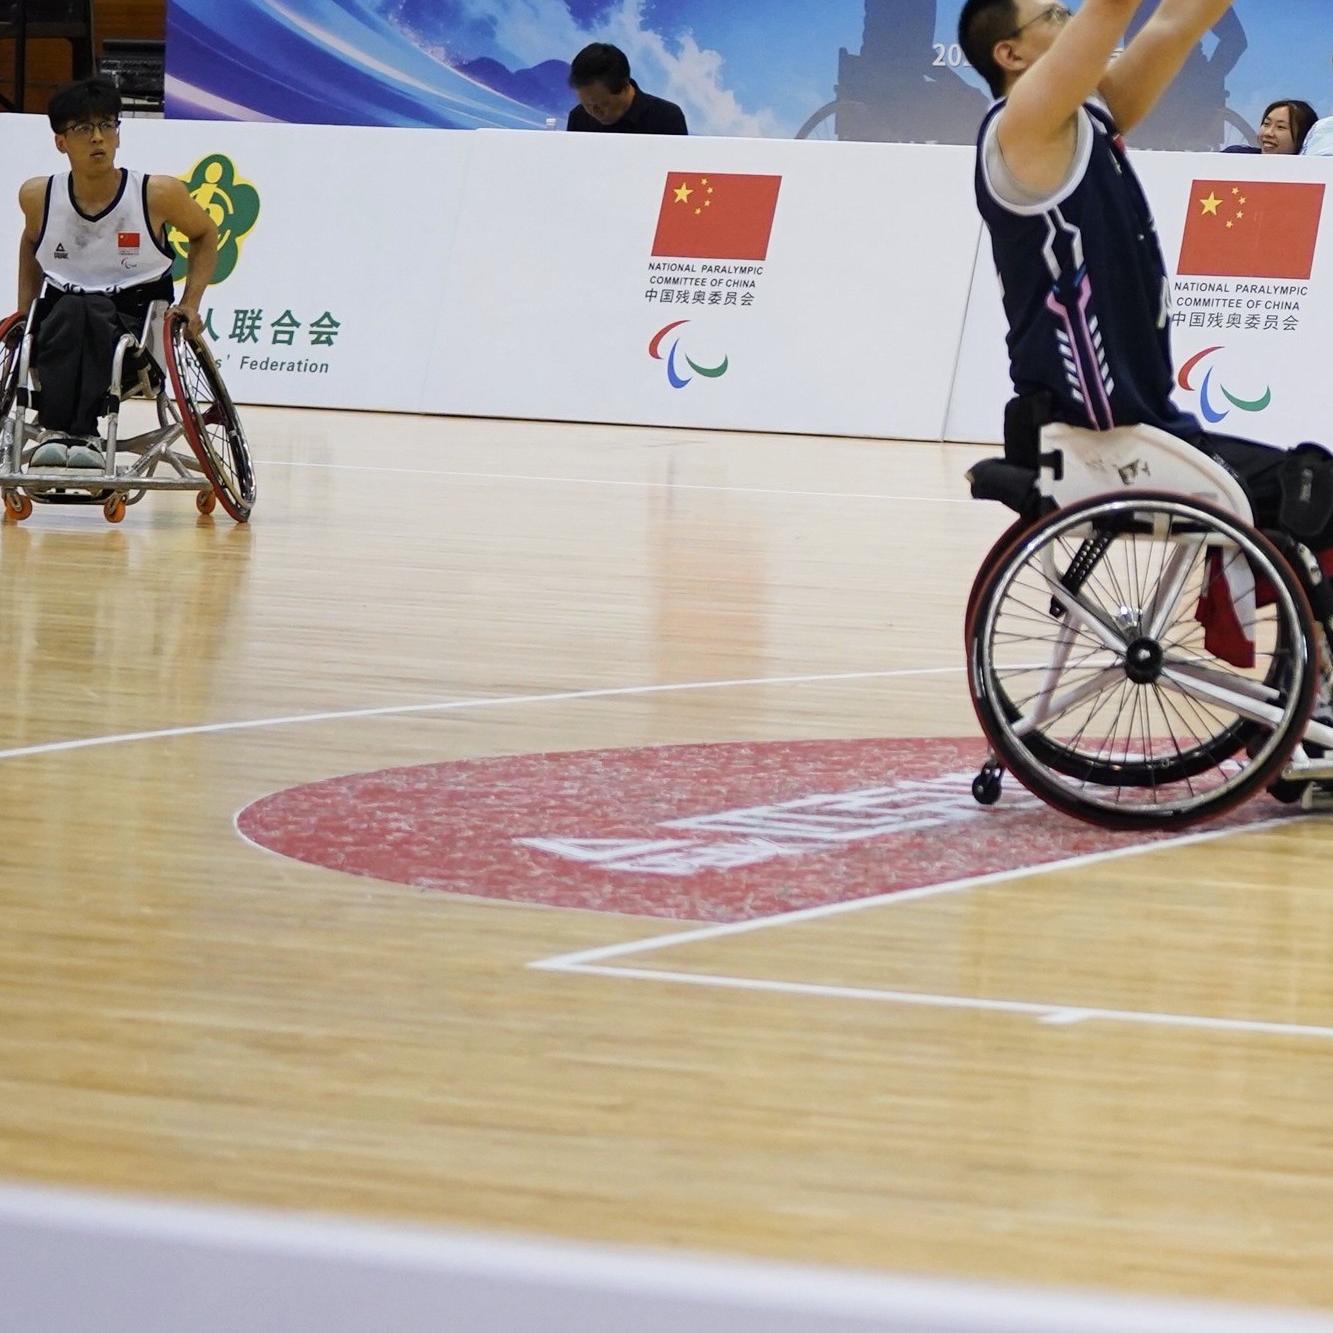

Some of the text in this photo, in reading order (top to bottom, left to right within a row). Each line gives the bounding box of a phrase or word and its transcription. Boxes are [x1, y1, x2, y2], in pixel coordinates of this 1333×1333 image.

[648, 263, 764, 276] NATIONAL PARALYMPIC
[649, 275, 756, 288] COMMITTEE OF CHINA
[1174, 282, 1308, 296] NATIONAL PARALYMPIC
[644, 288, 755, 306] 中国残奥委员会
[1176, 297, 1300, 311] COMMITTEE OF CHINA
[1172, 311, 1299, 331] 中国残奥委员会
[239, 355, 330, 374] Federation
